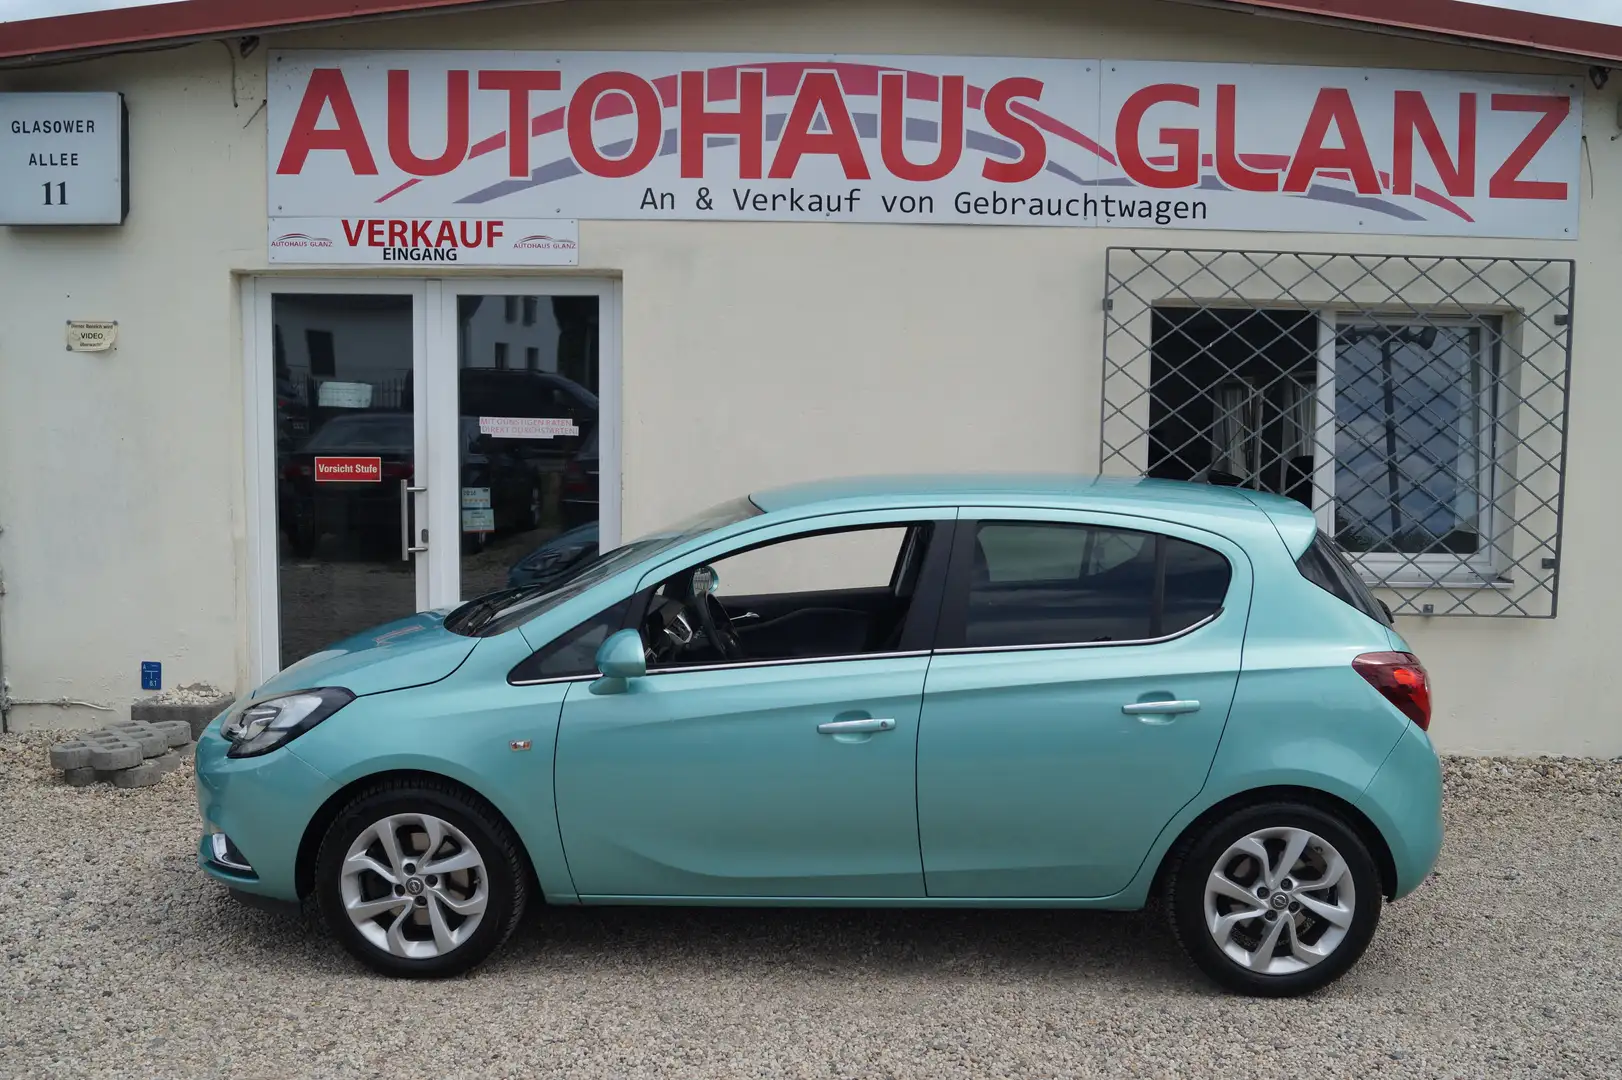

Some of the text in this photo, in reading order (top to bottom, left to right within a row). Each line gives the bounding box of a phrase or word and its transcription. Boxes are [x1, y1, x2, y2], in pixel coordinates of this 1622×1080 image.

[11, 120, 95, 134] GLASOWER
[276, 67, 1571, 201] AUTOHAUS GLANZ
[28, 153, 79, 166] ALLEE
[42, 181, 69, 206] 11
[640, 187, 1208, 225] An & Verkauf von Gebrauchtwagen
[342, 219, 504, 248] VERKAUF
[271, 240, 333, 248] AUTOHAUS GLANZ
[552, 242, 576, 250] GLANZ
[383, 247, 458, 261] EINGANG
[481, 425, 510, 434] DIREKT
[318, 463, 378, 474] Vorsicht Stufe
